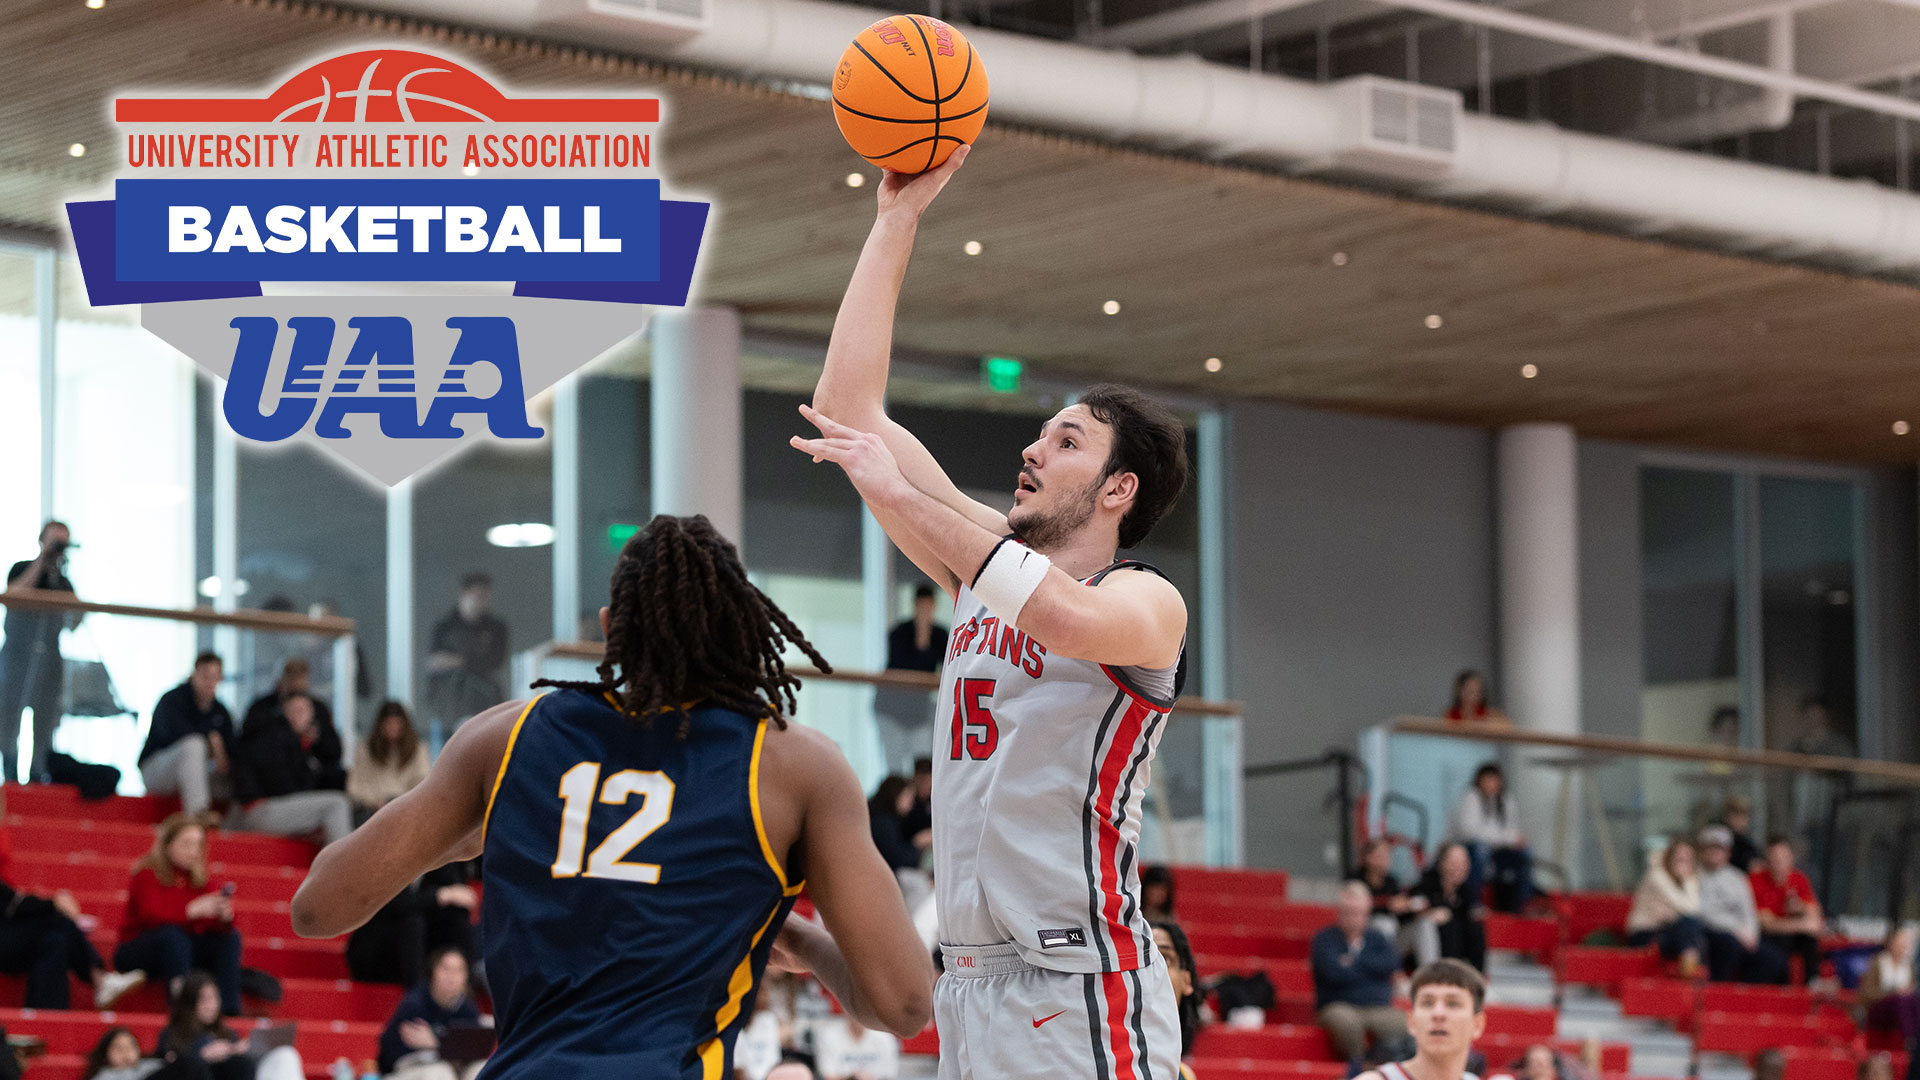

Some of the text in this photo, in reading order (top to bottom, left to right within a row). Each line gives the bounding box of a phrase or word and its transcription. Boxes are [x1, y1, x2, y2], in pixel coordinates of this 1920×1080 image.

[950, 677, 999, 760] 15
[551, 761, 676, 884] 12
[1069, 932, 1082, 941] XL
